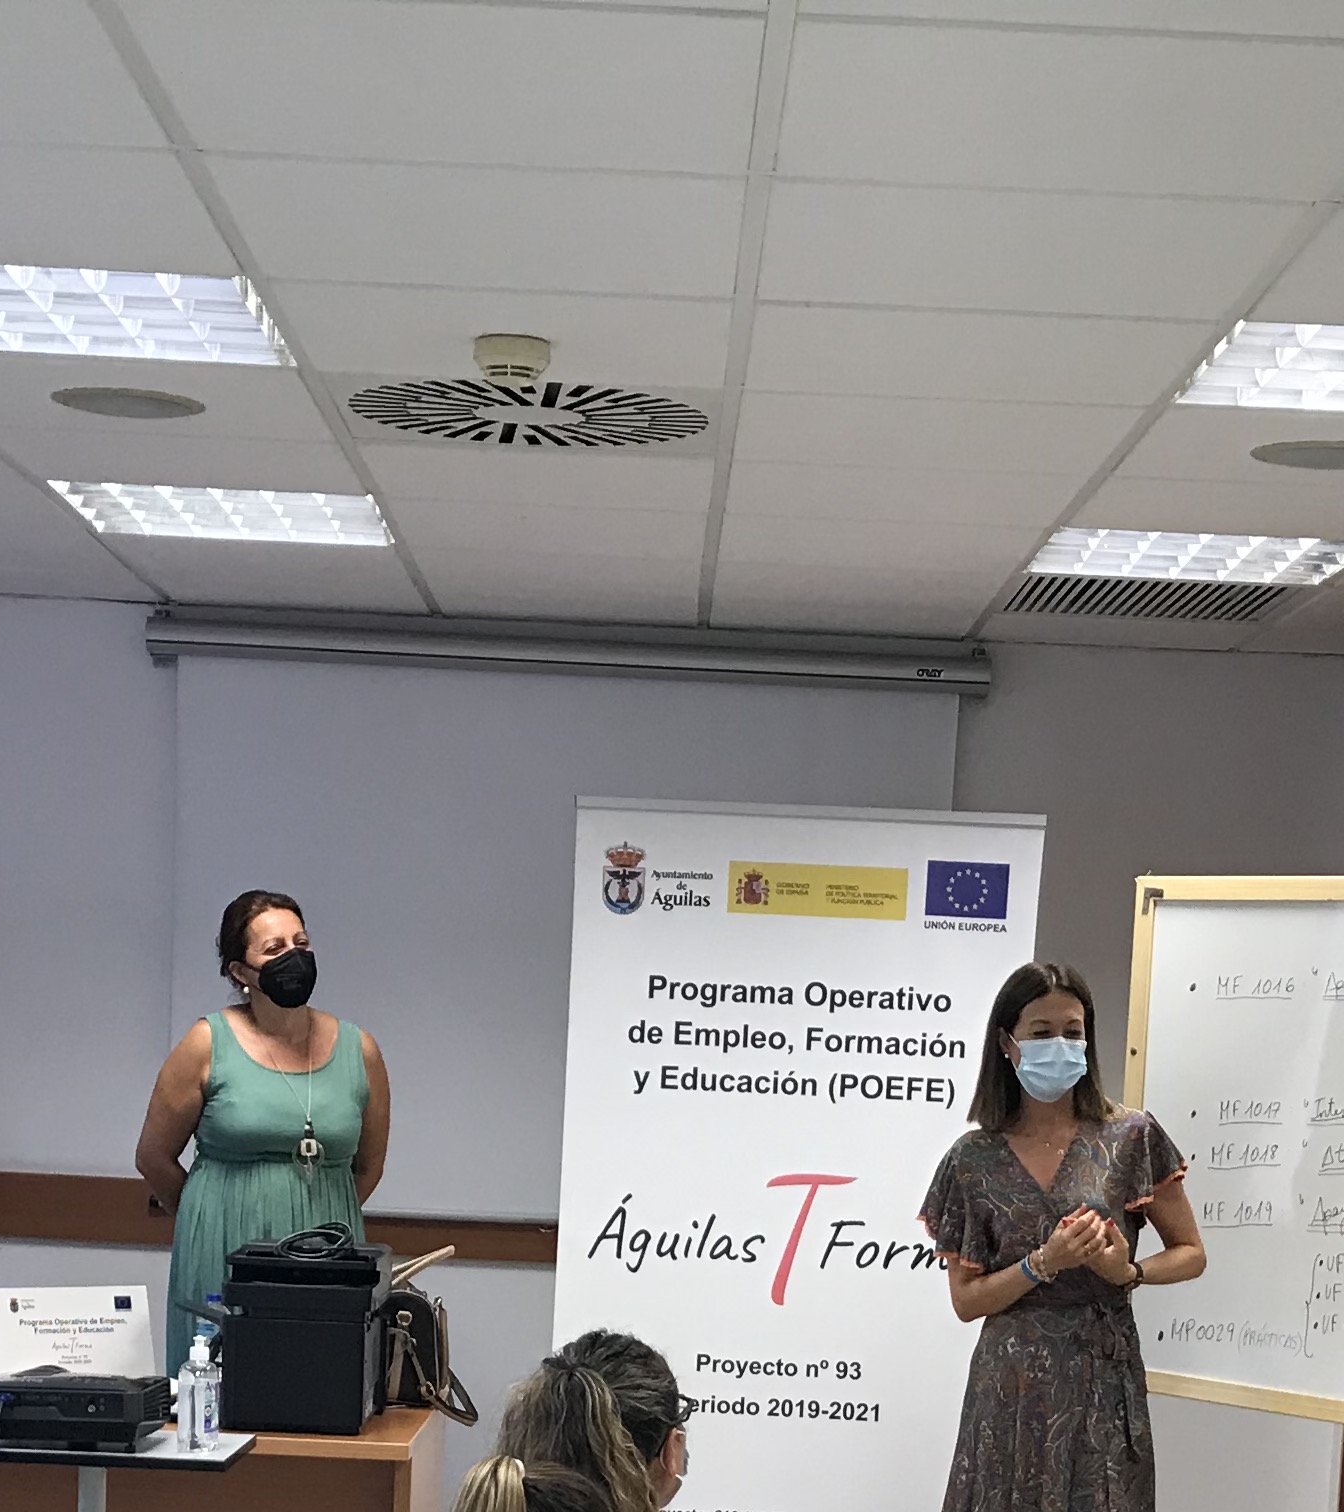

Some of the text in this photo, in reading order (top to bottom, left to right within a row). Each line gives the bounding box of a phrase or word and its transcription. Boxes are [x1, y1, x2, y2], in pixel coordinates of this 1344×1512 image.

[651, 869, 714, 881] Ayuntamiento
[676, 881, 687, 891] de
[650, 888, 711, 911] Águilas
[924, 920, 1007, 933] UNIÓN EUROPEA
[647, 974, 953, 1014] Programa Operativo
[1216, 977, 1243, 996] MF
[1252, 975, 1296, 995] 1016
[628, 1020, 967, 1060] de Empleo, Formación
[633, 1065, 956, 1109] y Educación (POEFE)
[1220, 1103, 1240, 1119] MF
[1244, 1101, 1282, 1119] 1017
[1211, 1145, 1235, 1163] MF
[1241, 1144, 1279, 1164] 1018
[1203, 1201, 1224, 1220] MF
[1234, 1200, 1273, 1221] 1019
[587, 1193, 766, 1273] Águilas
[819, 1220, 949, 1270] Form
[19, 1318, 54, 1328] Programa
[54, 1317, 88, 1328] Operativo
[89, 1318, 98, 1326] de
[34, 1326, 71, 1336] Formación
[78, 1326, 114, 1335] Educación
[696, 1354, 798, 1379] Proyecto
[835, 1361, 862, 1380] 93
[685, 1395, 881, 1422] eriodo 2019-2021
